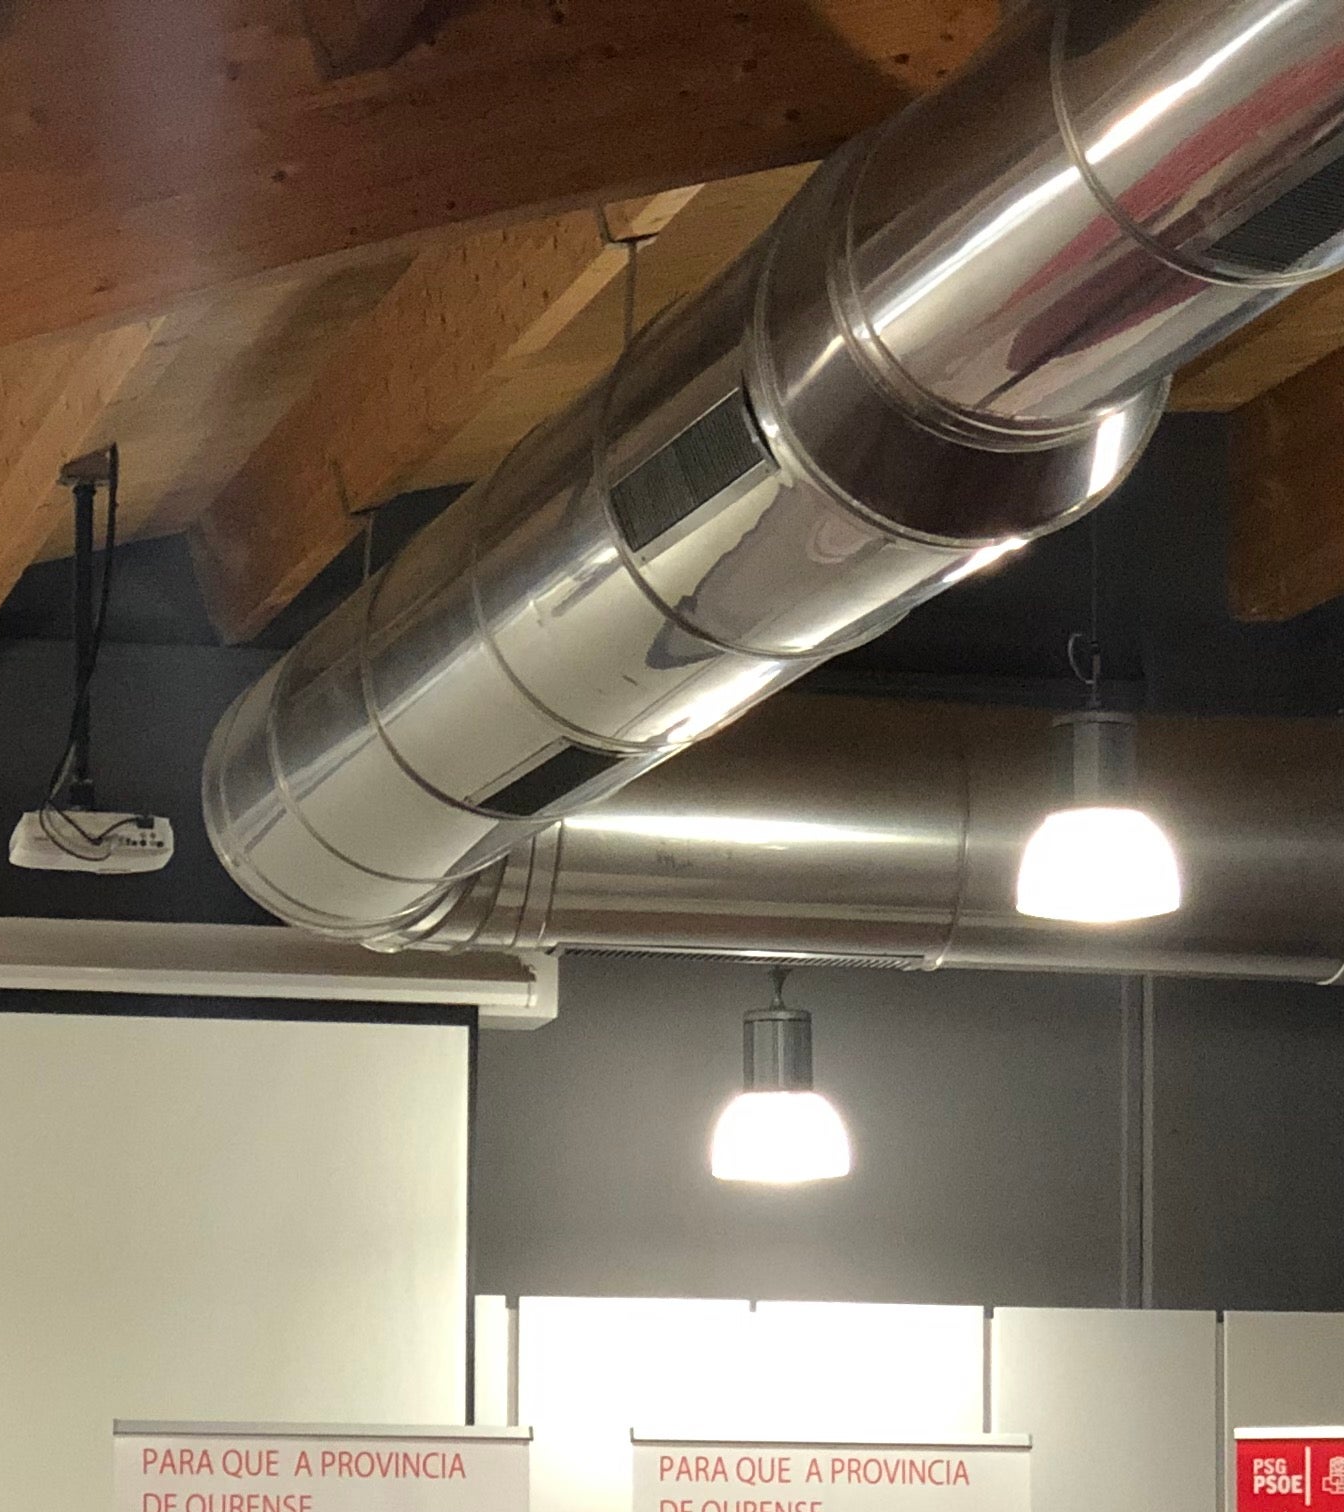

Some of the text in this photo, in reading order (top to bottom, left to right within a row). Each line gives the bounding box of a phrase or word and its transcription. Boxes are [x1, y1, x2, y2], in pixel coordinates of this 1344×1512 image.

[143, 1448, 466, 1479] PARA QUE A PROVINCIA
[659, 1456, 970, 1486] PARA QUE A PROVINCIA
[1253, 1458, 1287, 1474] PSG
[1253, 1475, 1302, 1495] PSOE
